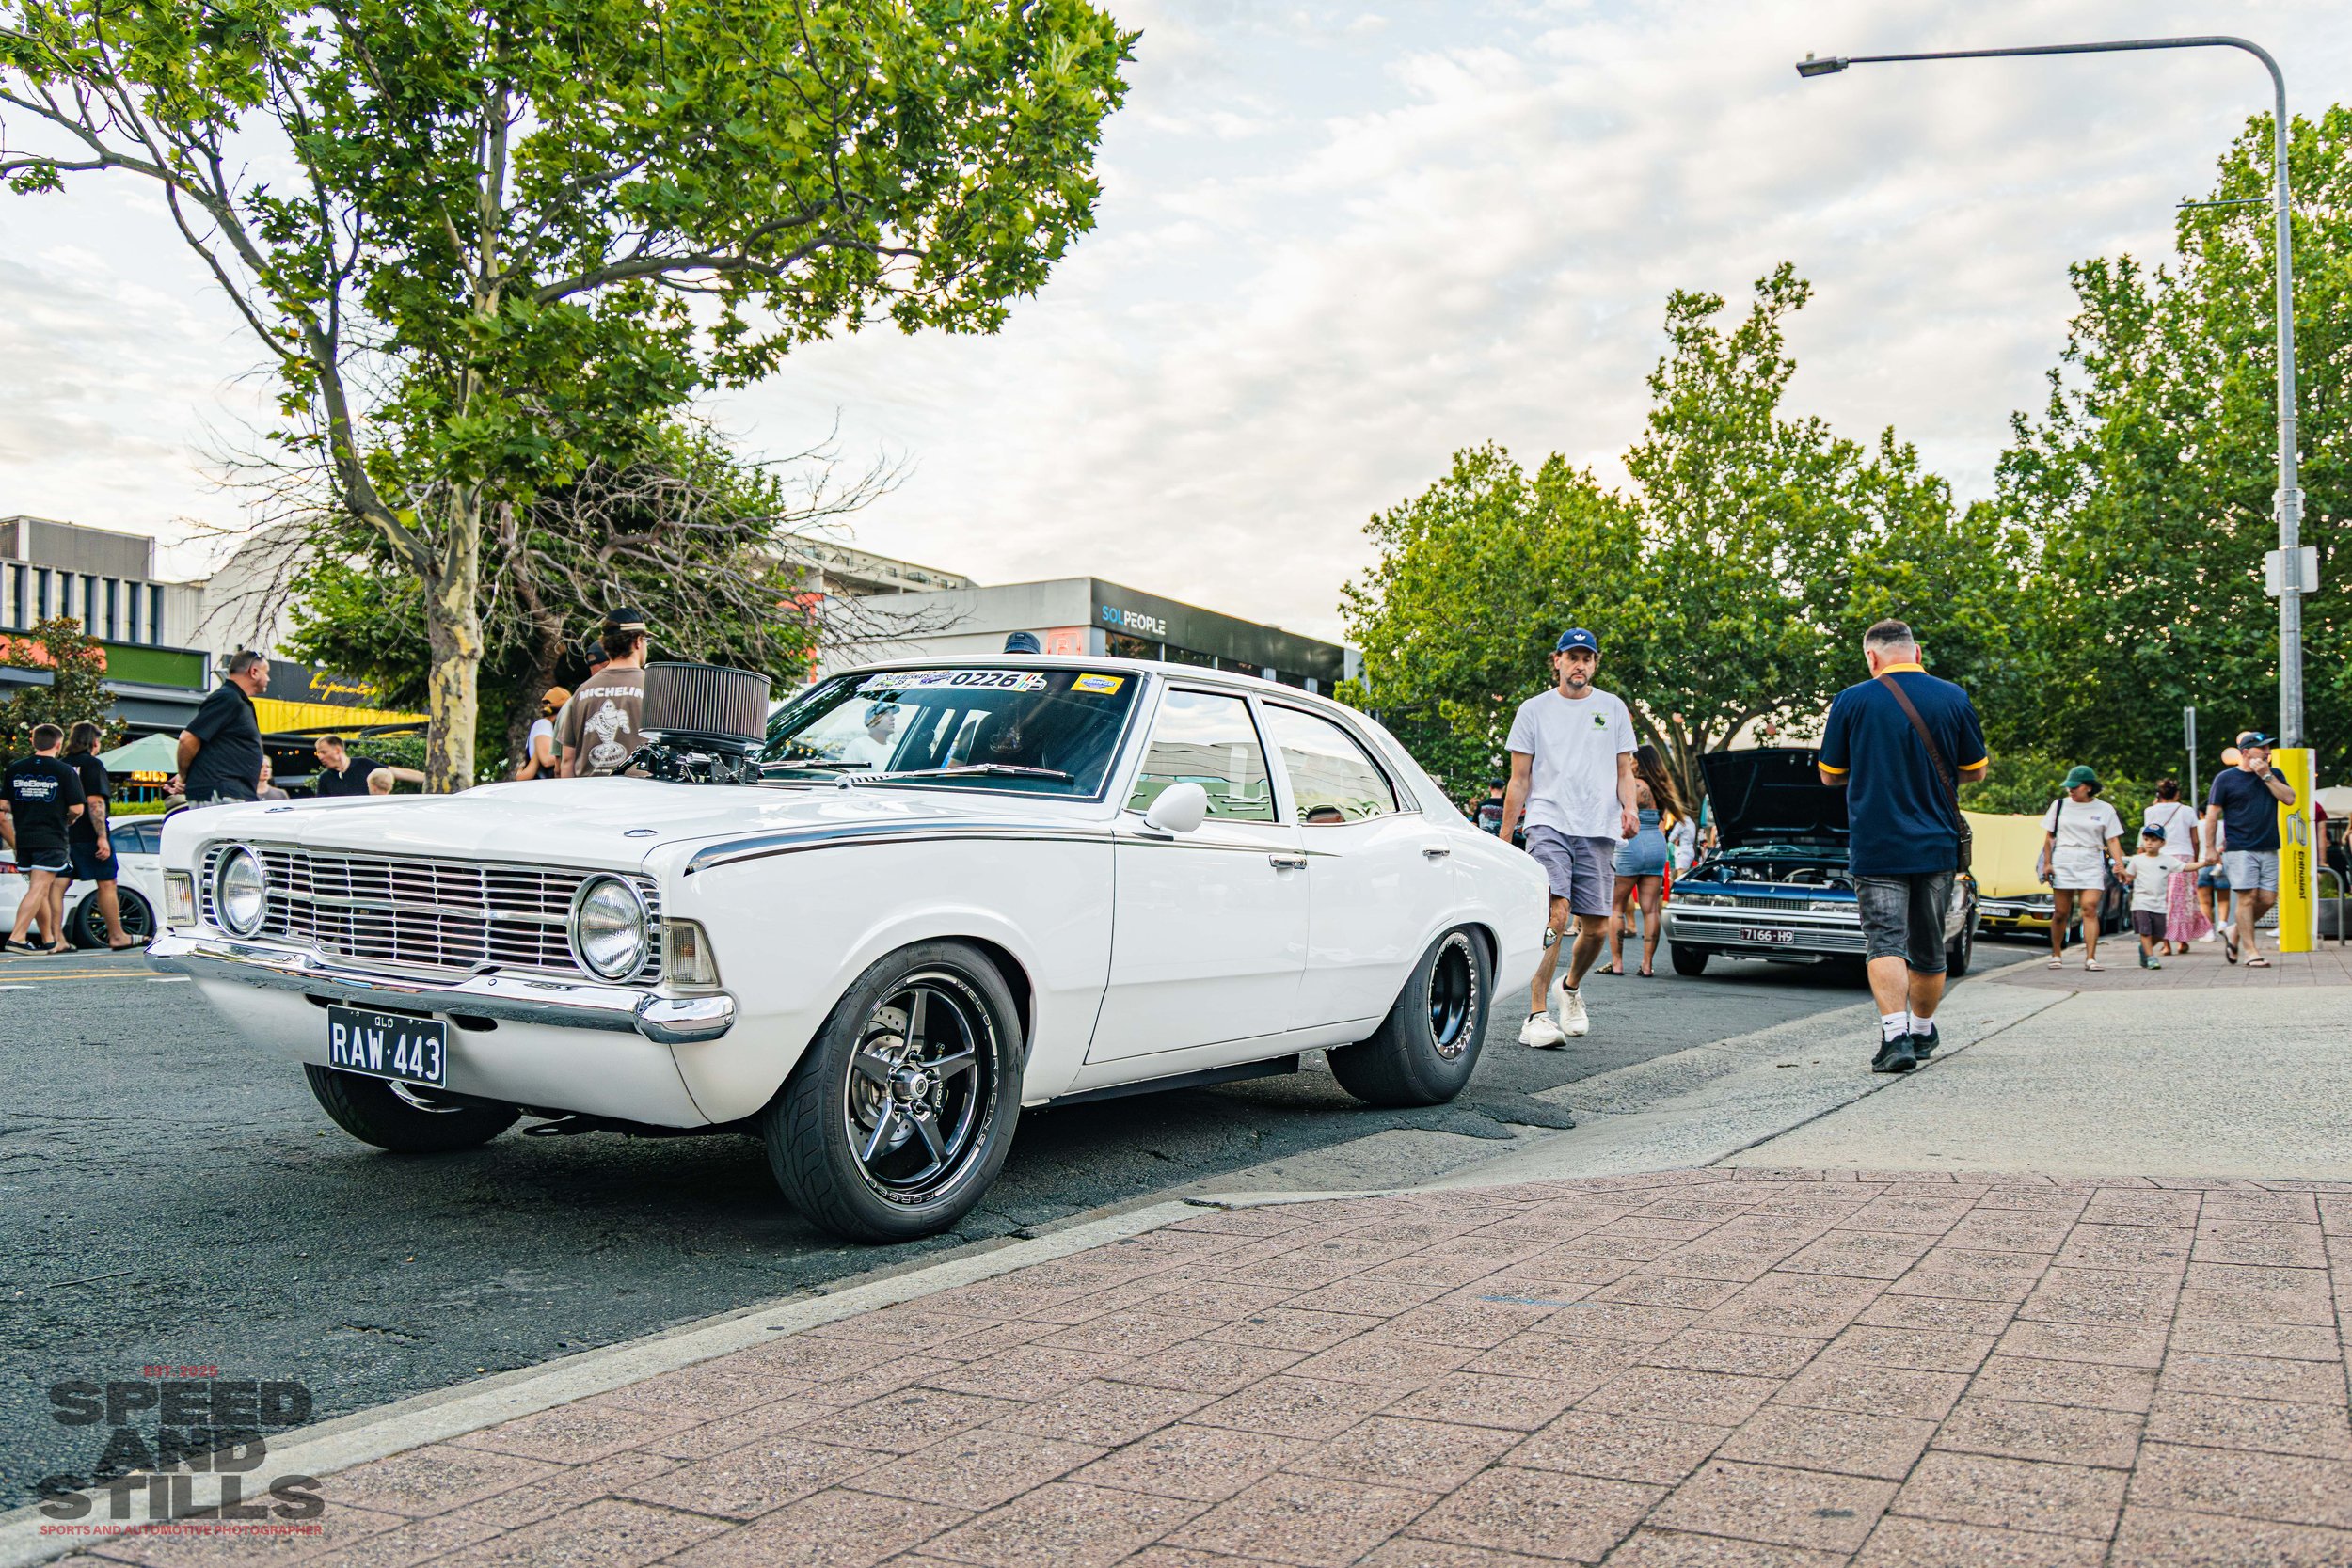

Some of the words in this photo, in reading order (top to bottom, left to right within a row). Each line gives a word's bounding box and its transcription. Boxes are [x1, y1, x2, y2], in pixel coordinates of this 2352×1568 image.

[1102, 605, 1166, 635] SOLPEOPLE
[949, 673, 1021, 686] 0226
[579, 687, 644, 701] MICHELIN
[956, 979, 992, 1027] WELD
[374, 1016, 394, 1028] QLD
[977, 1057, 999, 1148] RACING
[868, 1178, 936, 1204] FORGED
